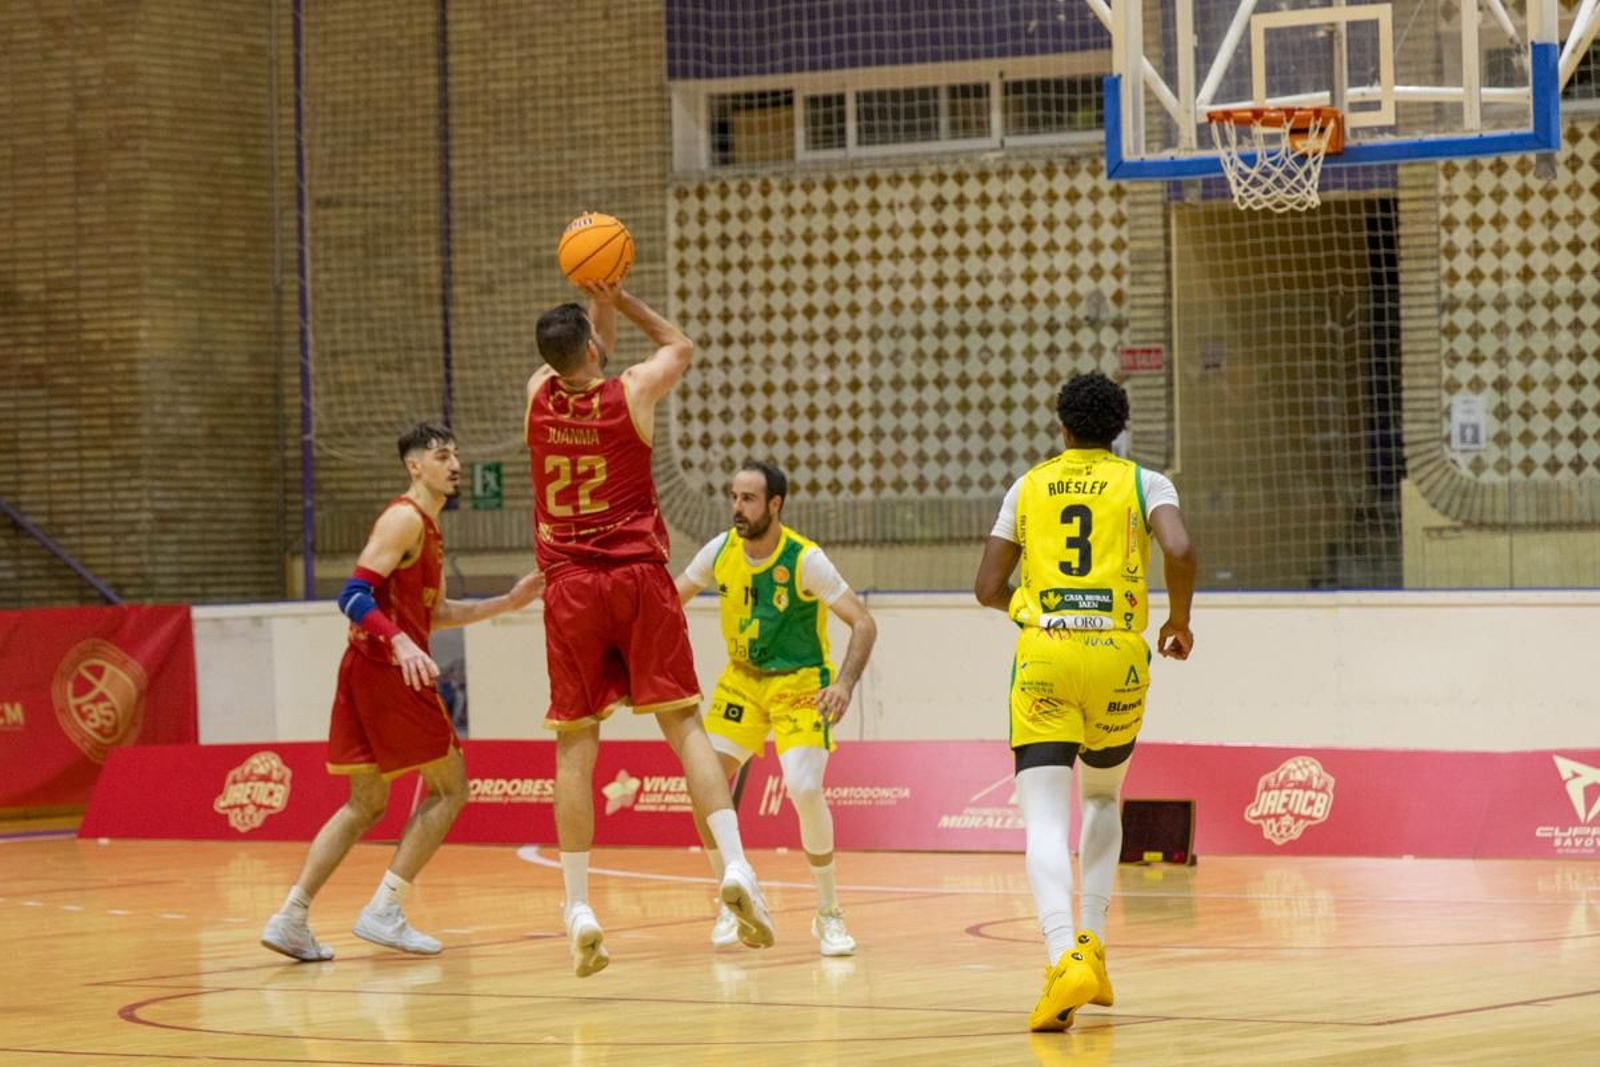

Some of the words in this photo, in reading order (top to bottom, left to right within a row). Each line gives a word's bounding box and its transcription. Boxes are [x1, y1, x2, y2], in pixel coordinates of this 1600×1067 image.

[544, 455, 610, 517] 22
[1059, 504, 1093, 577] 3
[1074, 616, 1103, 628] ORO
[82, 702, 116, 728] 35
[468, 779, 555, 796] ORDOBES
[821, 787, 911, 799] AORTODONCIA
